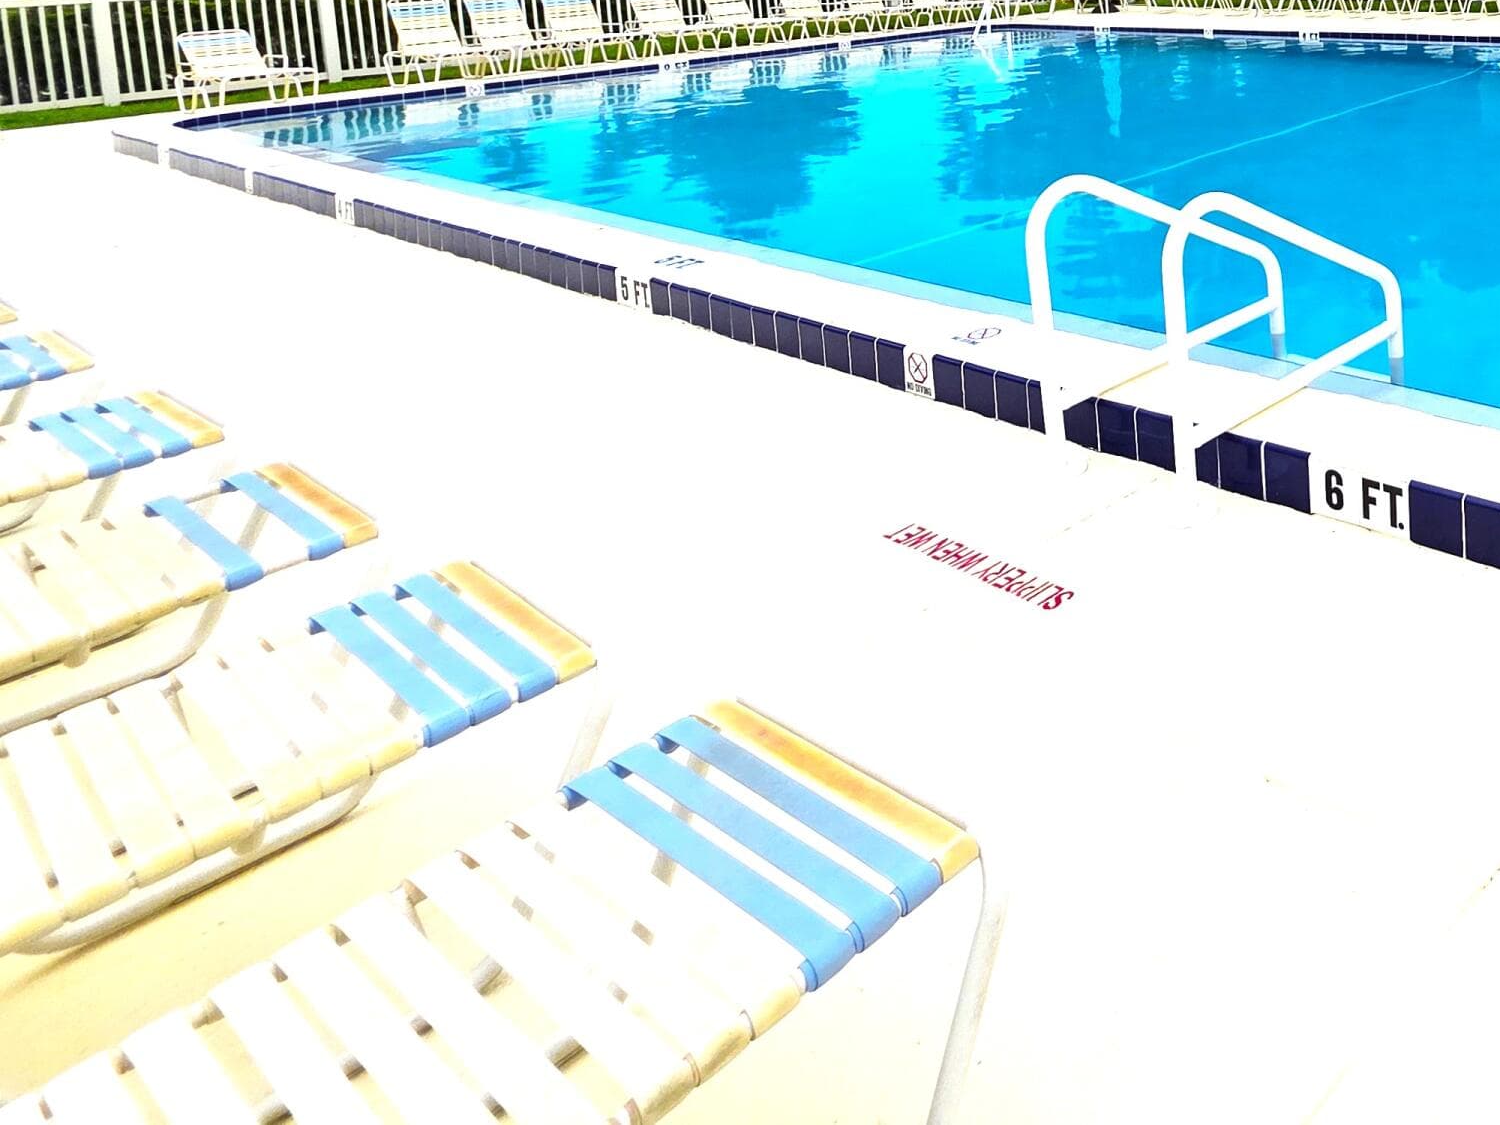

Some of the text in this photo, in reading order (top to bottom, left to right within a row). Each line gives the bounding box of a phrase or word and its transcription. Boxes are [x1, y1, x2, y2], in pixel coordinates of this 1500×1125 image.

[620, 275, 628, 301] 5
[1325, 469, 1404, 530] 6 FT.
[882, 523, 1075, 611] SLIPPERY WHEN WET
